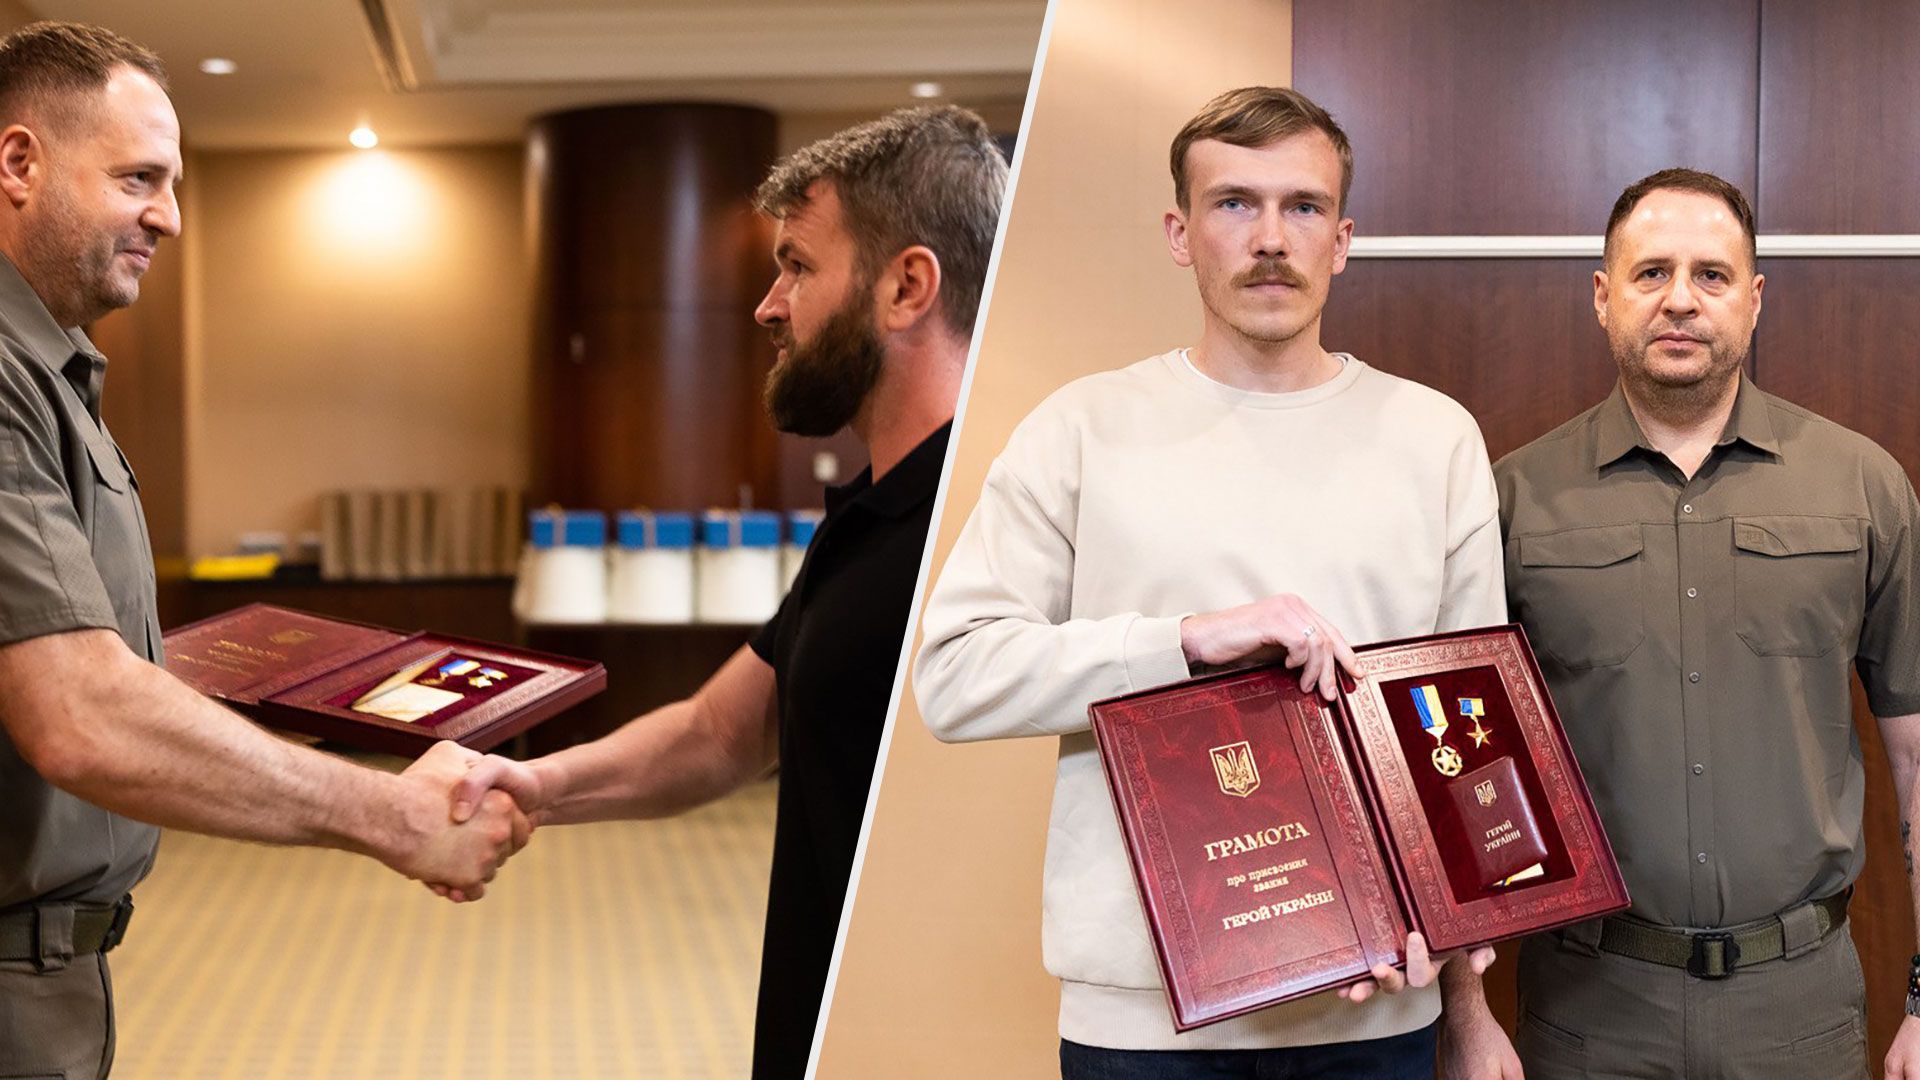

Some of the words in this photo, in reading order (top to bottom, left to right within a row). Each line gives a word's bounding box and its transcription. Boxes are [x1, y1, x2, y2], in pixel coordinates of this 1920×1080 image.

[1204, 822, 1310, 861] ГРАМОТА
[1227, 874, 1246, 887] про
[1222, 906, 1271, 930] ГЕРОЙ
[1272, 890, 1334, 916] УКРАЇНИ
